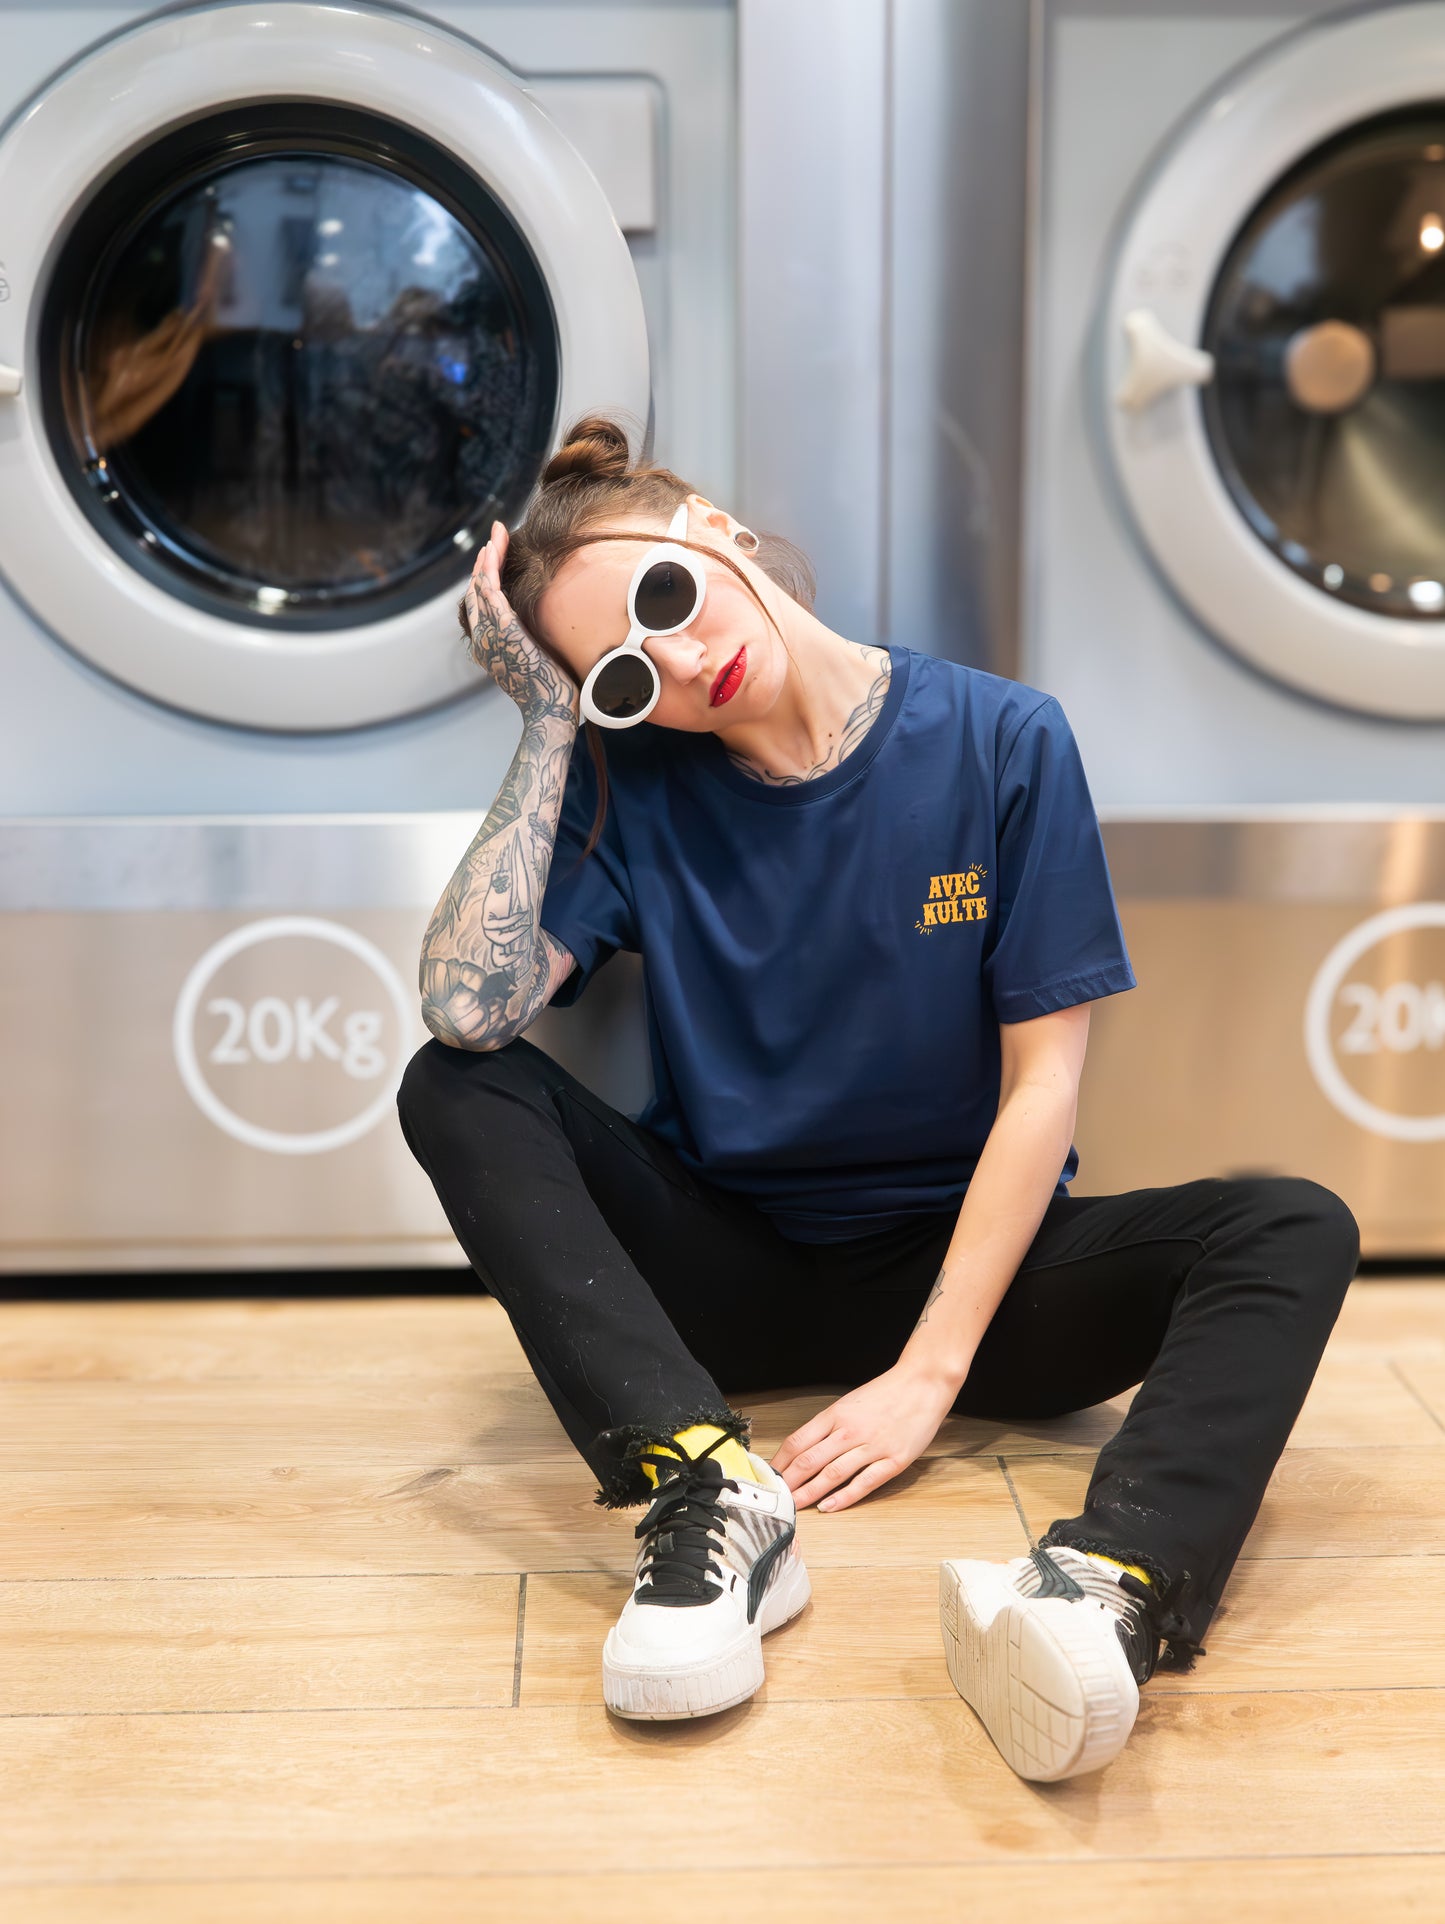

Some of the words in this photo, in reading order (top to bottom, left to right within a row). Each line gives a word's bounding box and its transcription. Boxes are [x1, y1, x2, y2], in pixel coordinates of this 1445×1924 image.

[928, 871, 980, 899] AVEC
[923, 896, 988, 926] KULTE
[208, 997, 385, 1079] 20Kg
